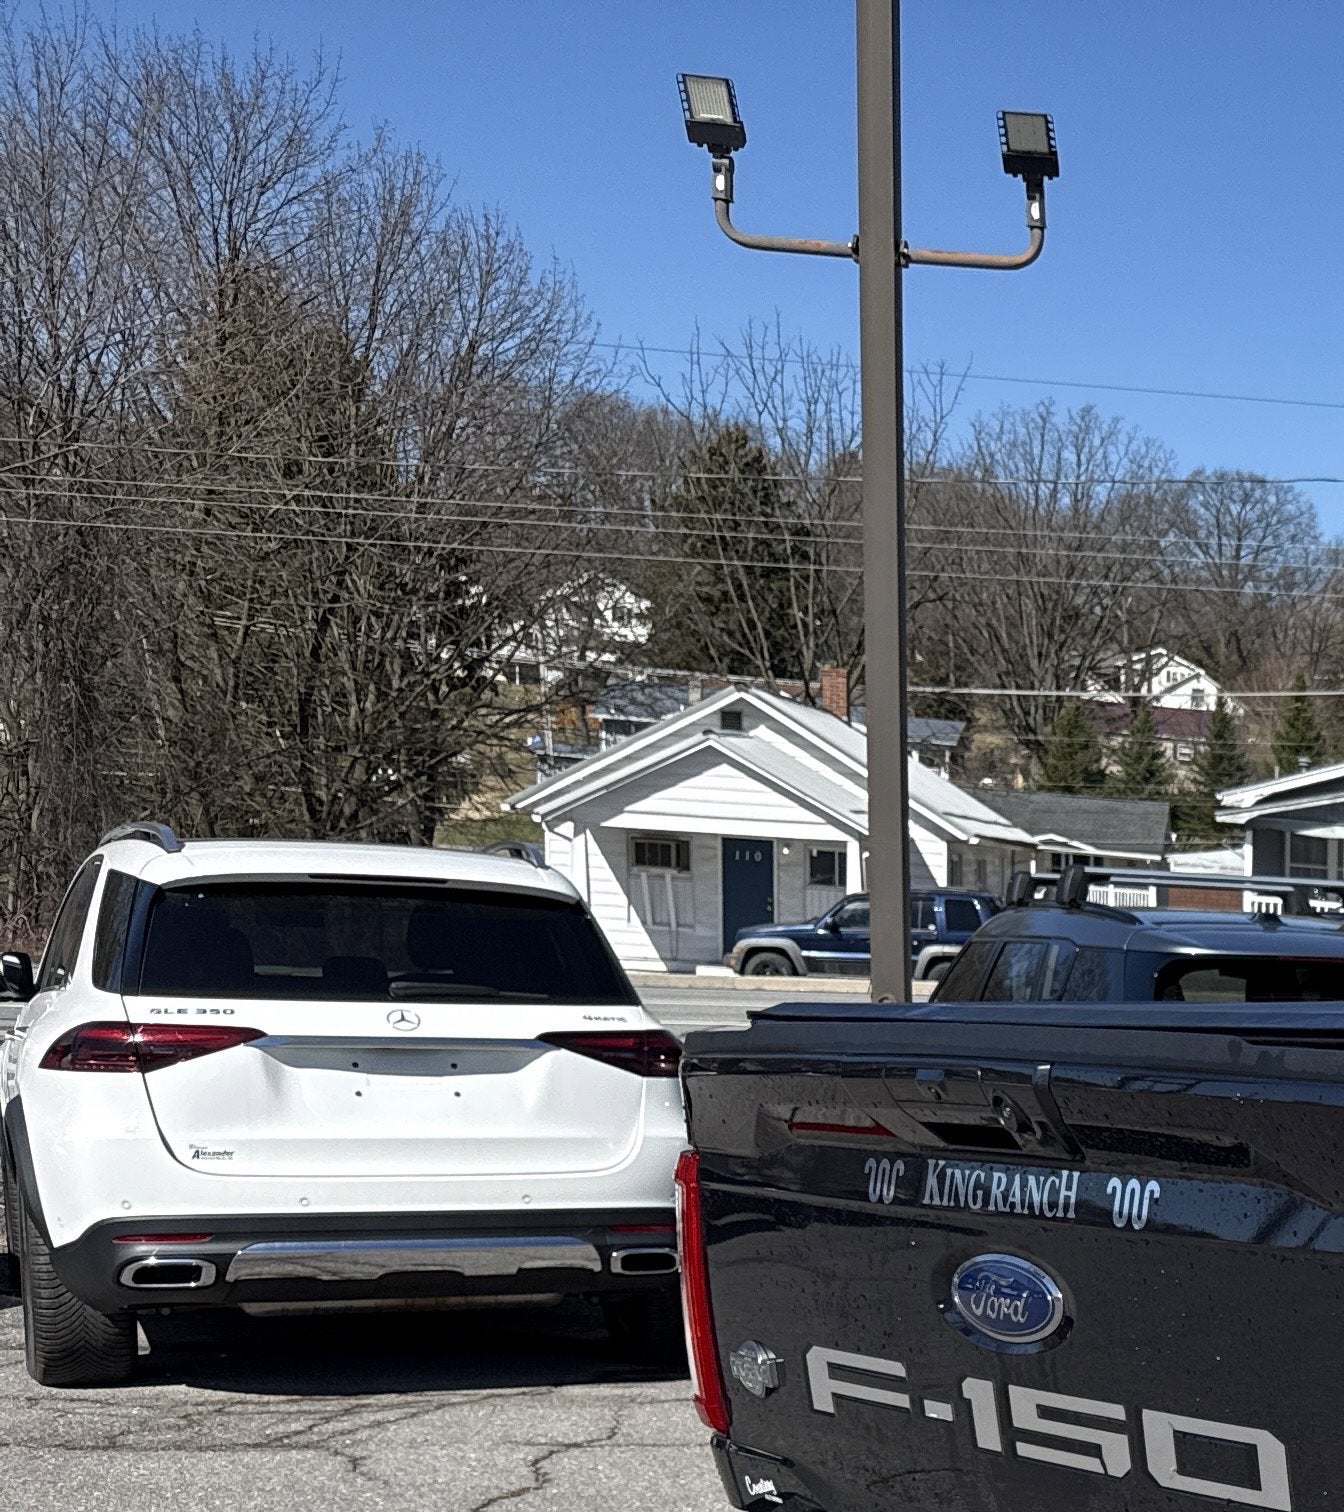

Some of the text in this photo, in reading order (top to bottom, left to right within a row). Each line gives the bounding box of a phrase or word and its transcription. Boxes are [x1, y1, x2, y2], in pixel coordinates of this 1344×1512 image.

[735, 850, 762, 862] 110
[149, 1007, 235, 1015] GLE 350
[921, 1158, 1081, 1219] KING RANCH
[970, 1270, 1029, 1325] Ford
[805, 1344, 1293, 1512] F-150
